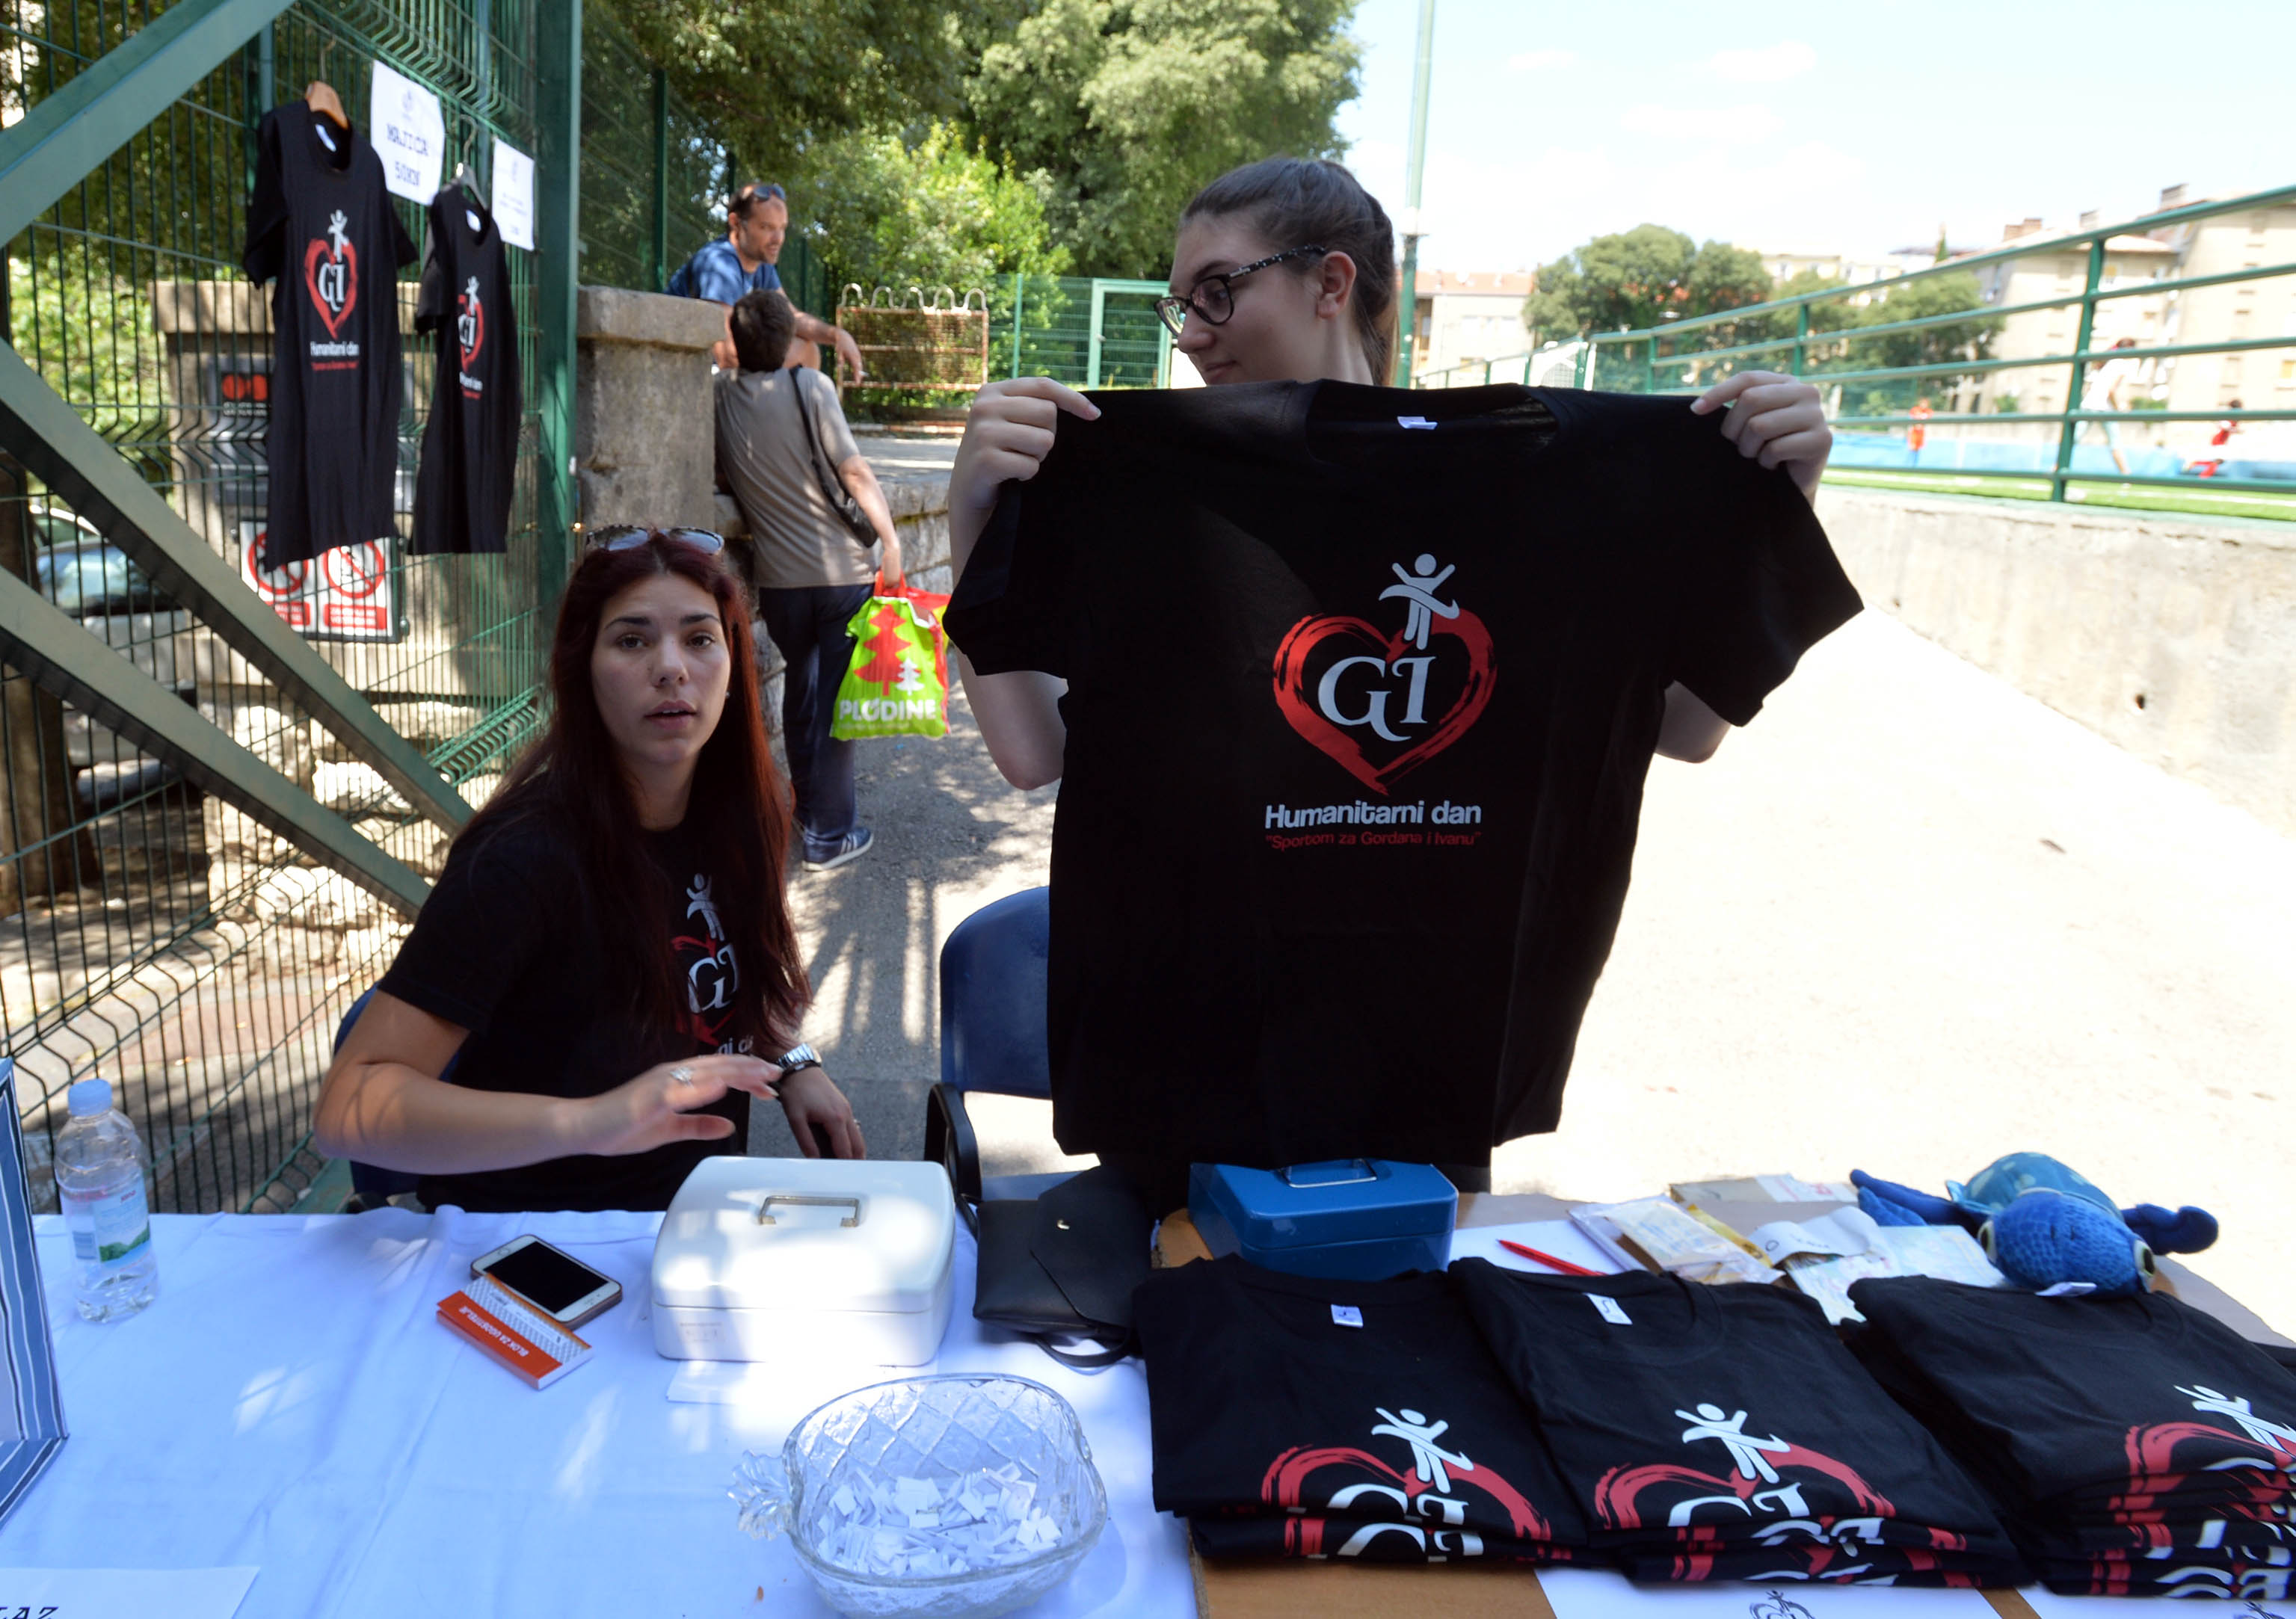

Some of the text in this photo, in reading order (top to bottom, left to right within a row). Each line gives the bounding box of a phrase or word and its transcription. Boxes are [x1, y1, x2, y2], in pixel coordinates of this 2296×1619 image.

[318, 262, 345, 312] GI
[839, 698, 937, 722] PLODINE
[1317, 656, 1436, 741] GI
[1265, 800, 1482, 829] Humanitarni dan
[1338, 835, 1356, 845] za
[1361, 830, 1422, 845] Gordana
[1426, 831, 1432, 845] i
[507, 1340, 529, 1357] BLOK
